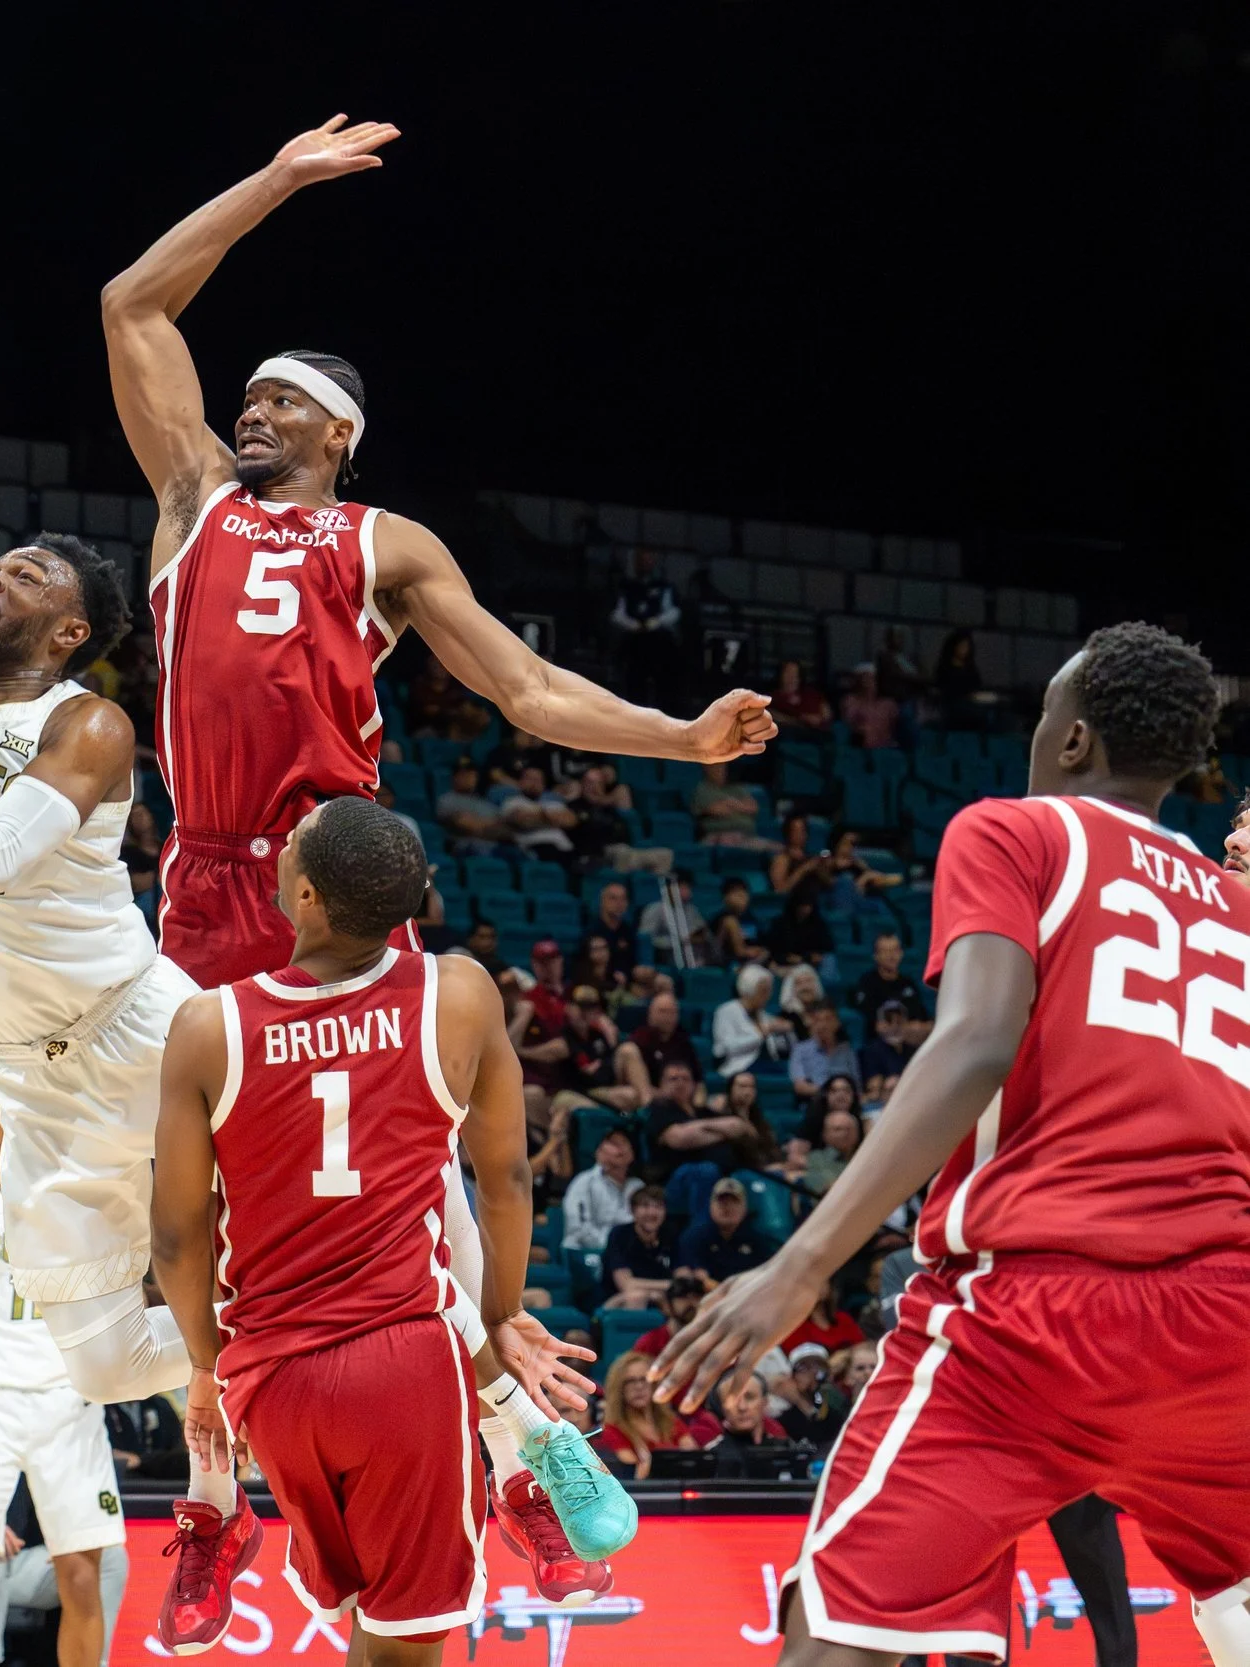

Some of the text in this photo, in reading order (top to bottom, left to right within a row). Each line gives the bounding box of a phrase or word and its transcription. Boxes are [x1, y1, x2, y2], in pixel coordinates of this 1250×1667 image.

[313, 510, 348, 529] SEC
[236, 549, 306, 636] 5
[1128, 835, 1230, 913] ATAK
[1086, 877, 1250, 1092] 22
[264, 1007, 403, 1065] BROWN
[310, 1070, 362, 1197] 1
